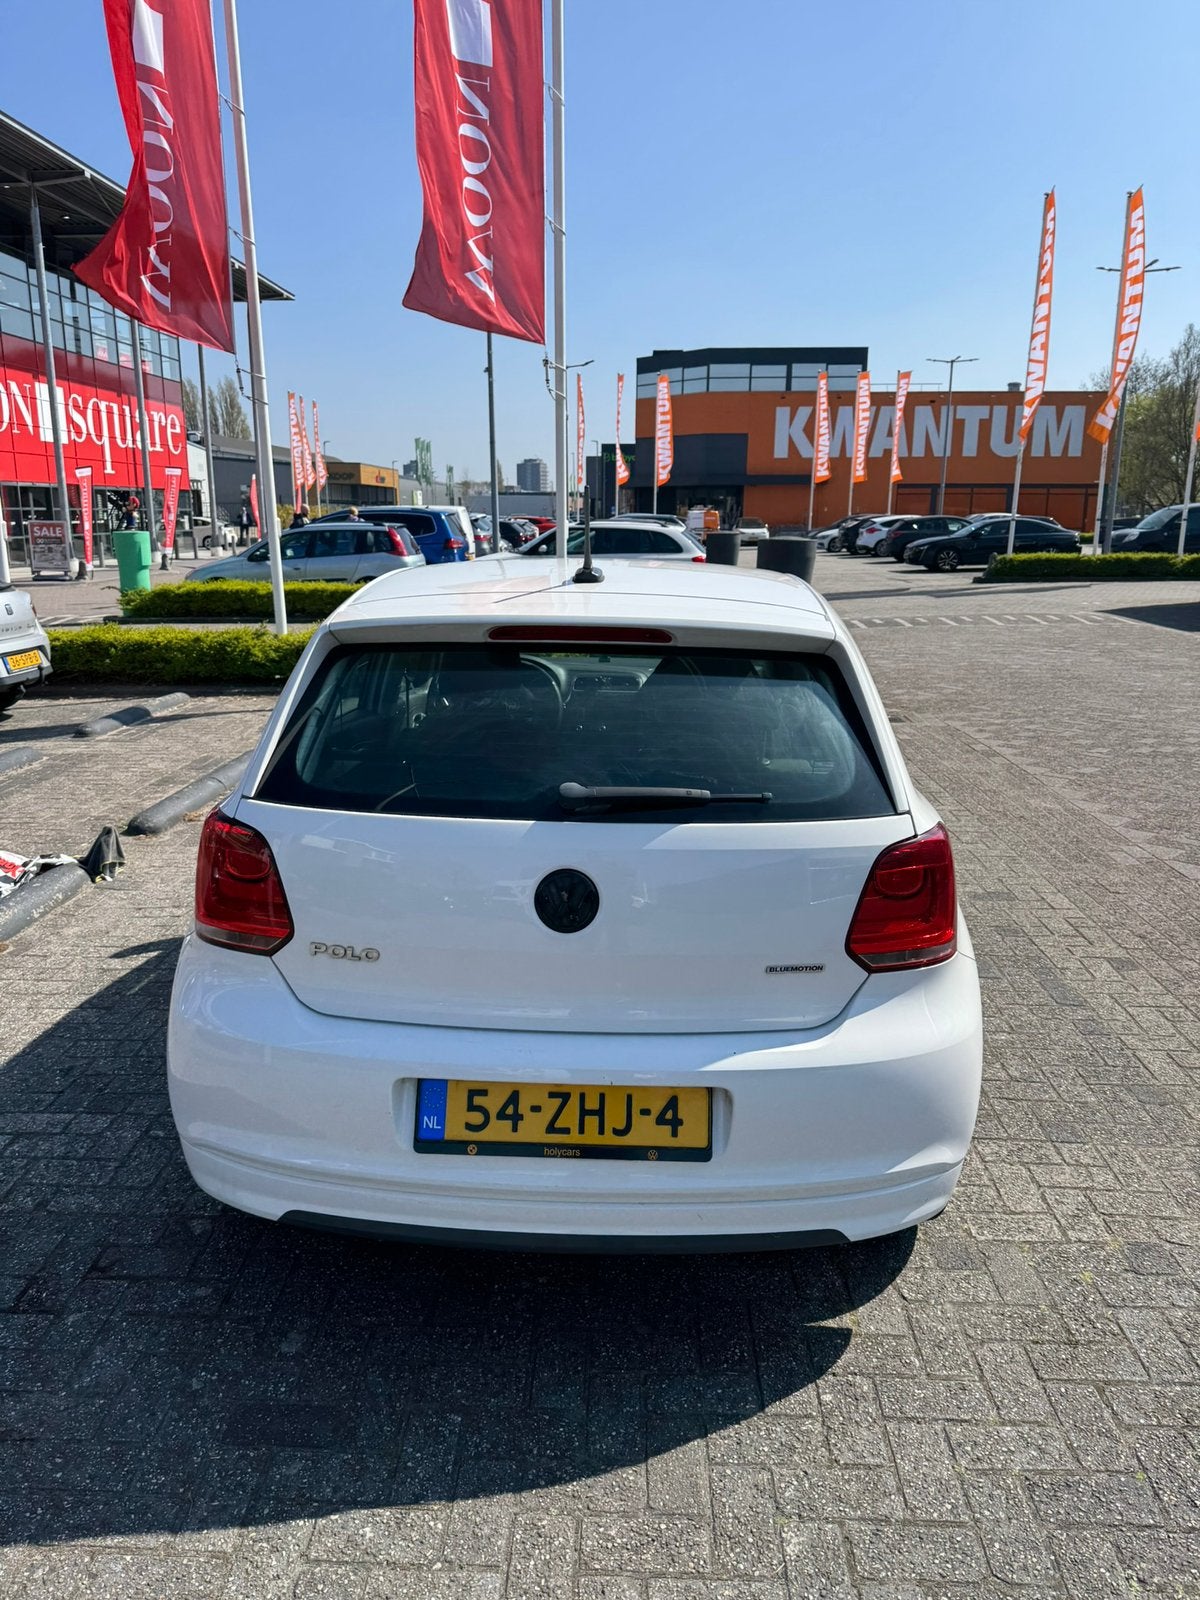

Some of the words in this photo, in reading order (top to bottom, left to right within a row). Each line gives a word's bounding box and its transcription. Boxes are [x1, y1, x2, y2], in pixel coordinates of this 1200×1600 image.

[69, 394, 182, 474] square
[657, 382, 673, 480] KWANTUM
[774, 404, 1086, 458] KWANTUM
[816, 379, 830, 477] KWANTUM
[855, 378, 870, 476] KWANTUM
[33, 526, 62, 537] SALE
[309, 941, 380, 962] POLO
[769, 965, 824, 973] BLUEMOTION
[423, 1115, 441, 1129] NL
[464, 1089, 683, 1137] 54-ZHJ-4
[543, 1147, 580, 1157] holycars
